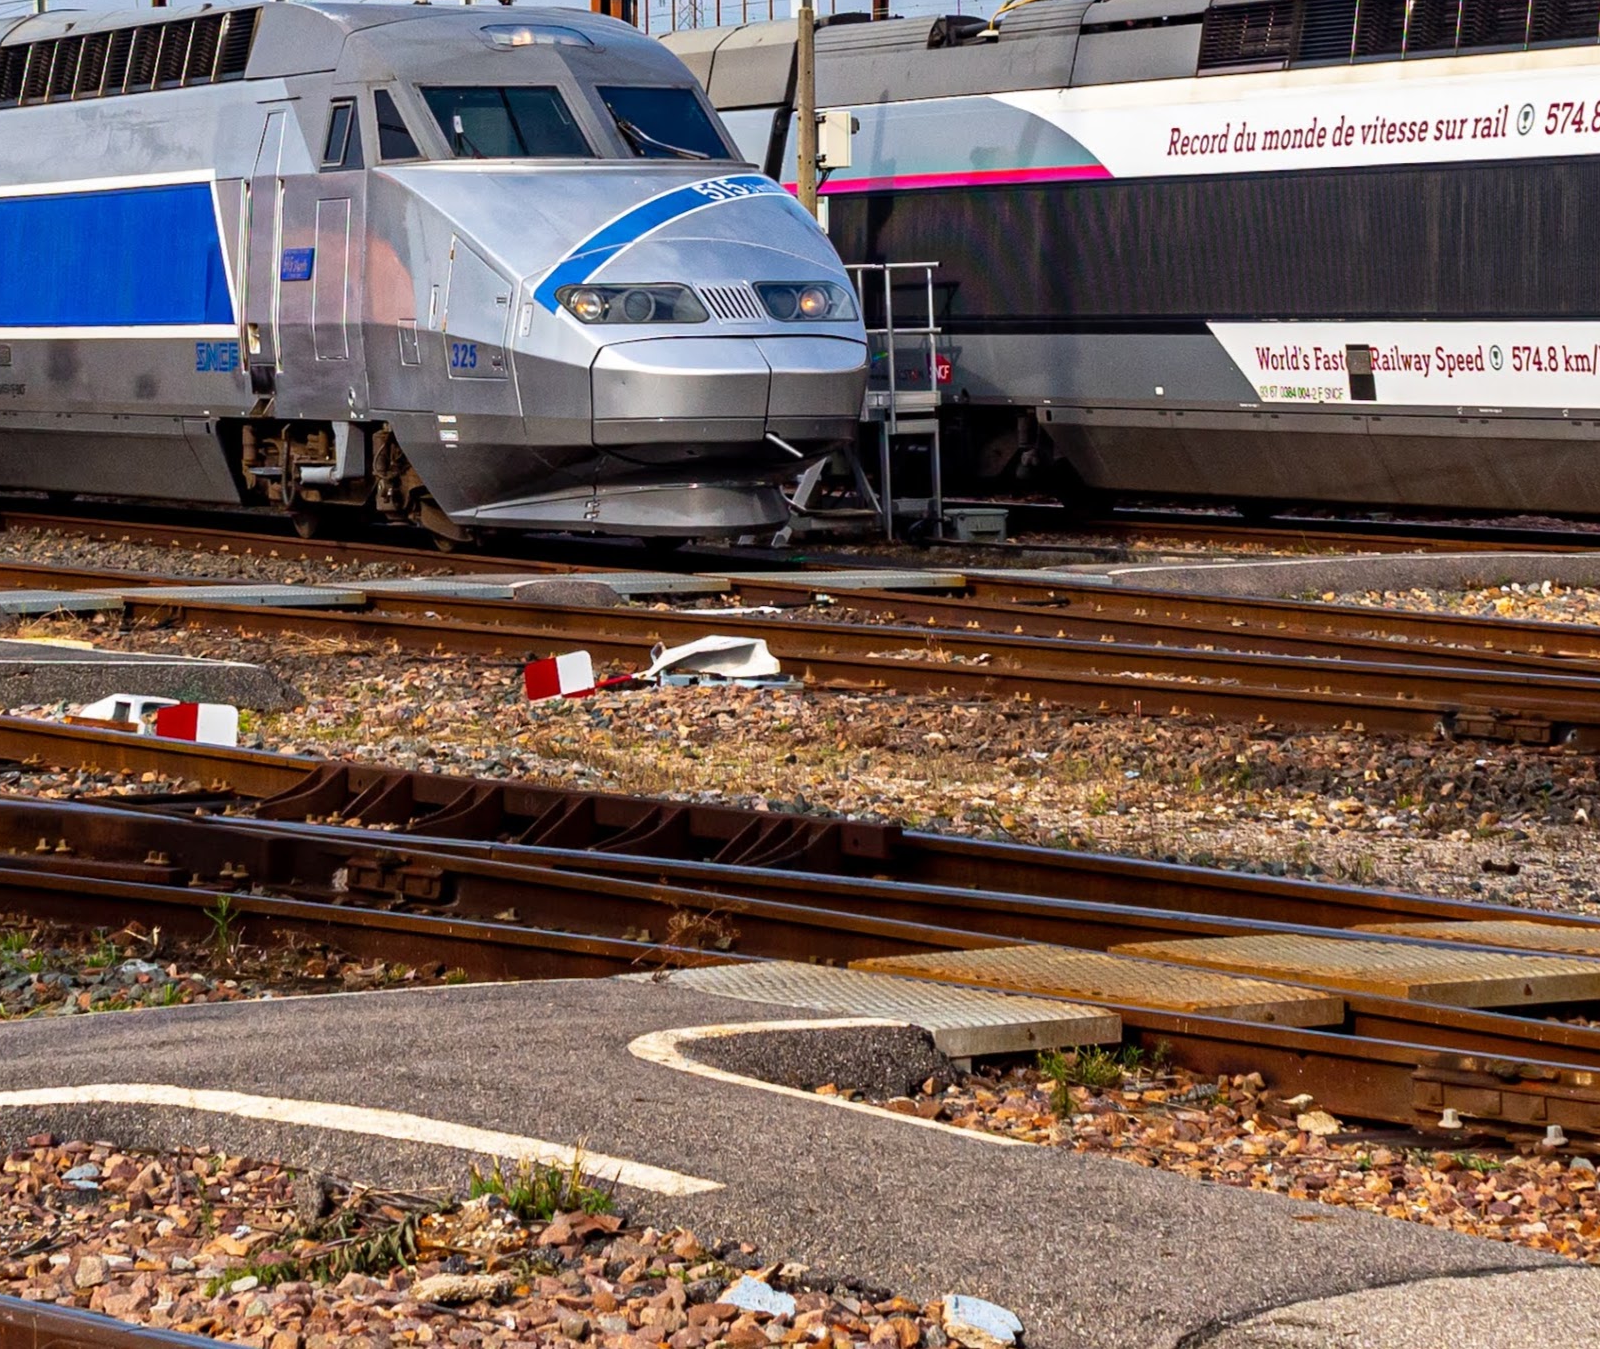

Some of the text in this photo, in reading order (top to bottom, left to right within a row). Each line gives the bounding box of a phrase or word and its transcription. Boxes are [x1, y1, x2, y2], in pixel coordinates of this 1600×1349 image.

[1167, 122, 1230, 156] Record
[1233, 121, 1256, 152] du
[1261, 117, 1326, 151] monde
[1332, 115, 1355, 147] de
[1361, 115, 1429, 145] vitesse
[1433, 117, 1468, 141] sur
[1471, 105, 1509, 139] rail
[195, 342, 239, 372] SNCF
[452, 343, 477, 368] 325
[1256, 345, 1310, 371] World's
[1313, 346, 1348, 371] Fast
[1369, 345, 1432, 378] Railway
[1436, 345, 1485, 378] Speed
[1512, 345, 1559, 372] 574.8
[1324, 387, 1344, 400] SNCF
